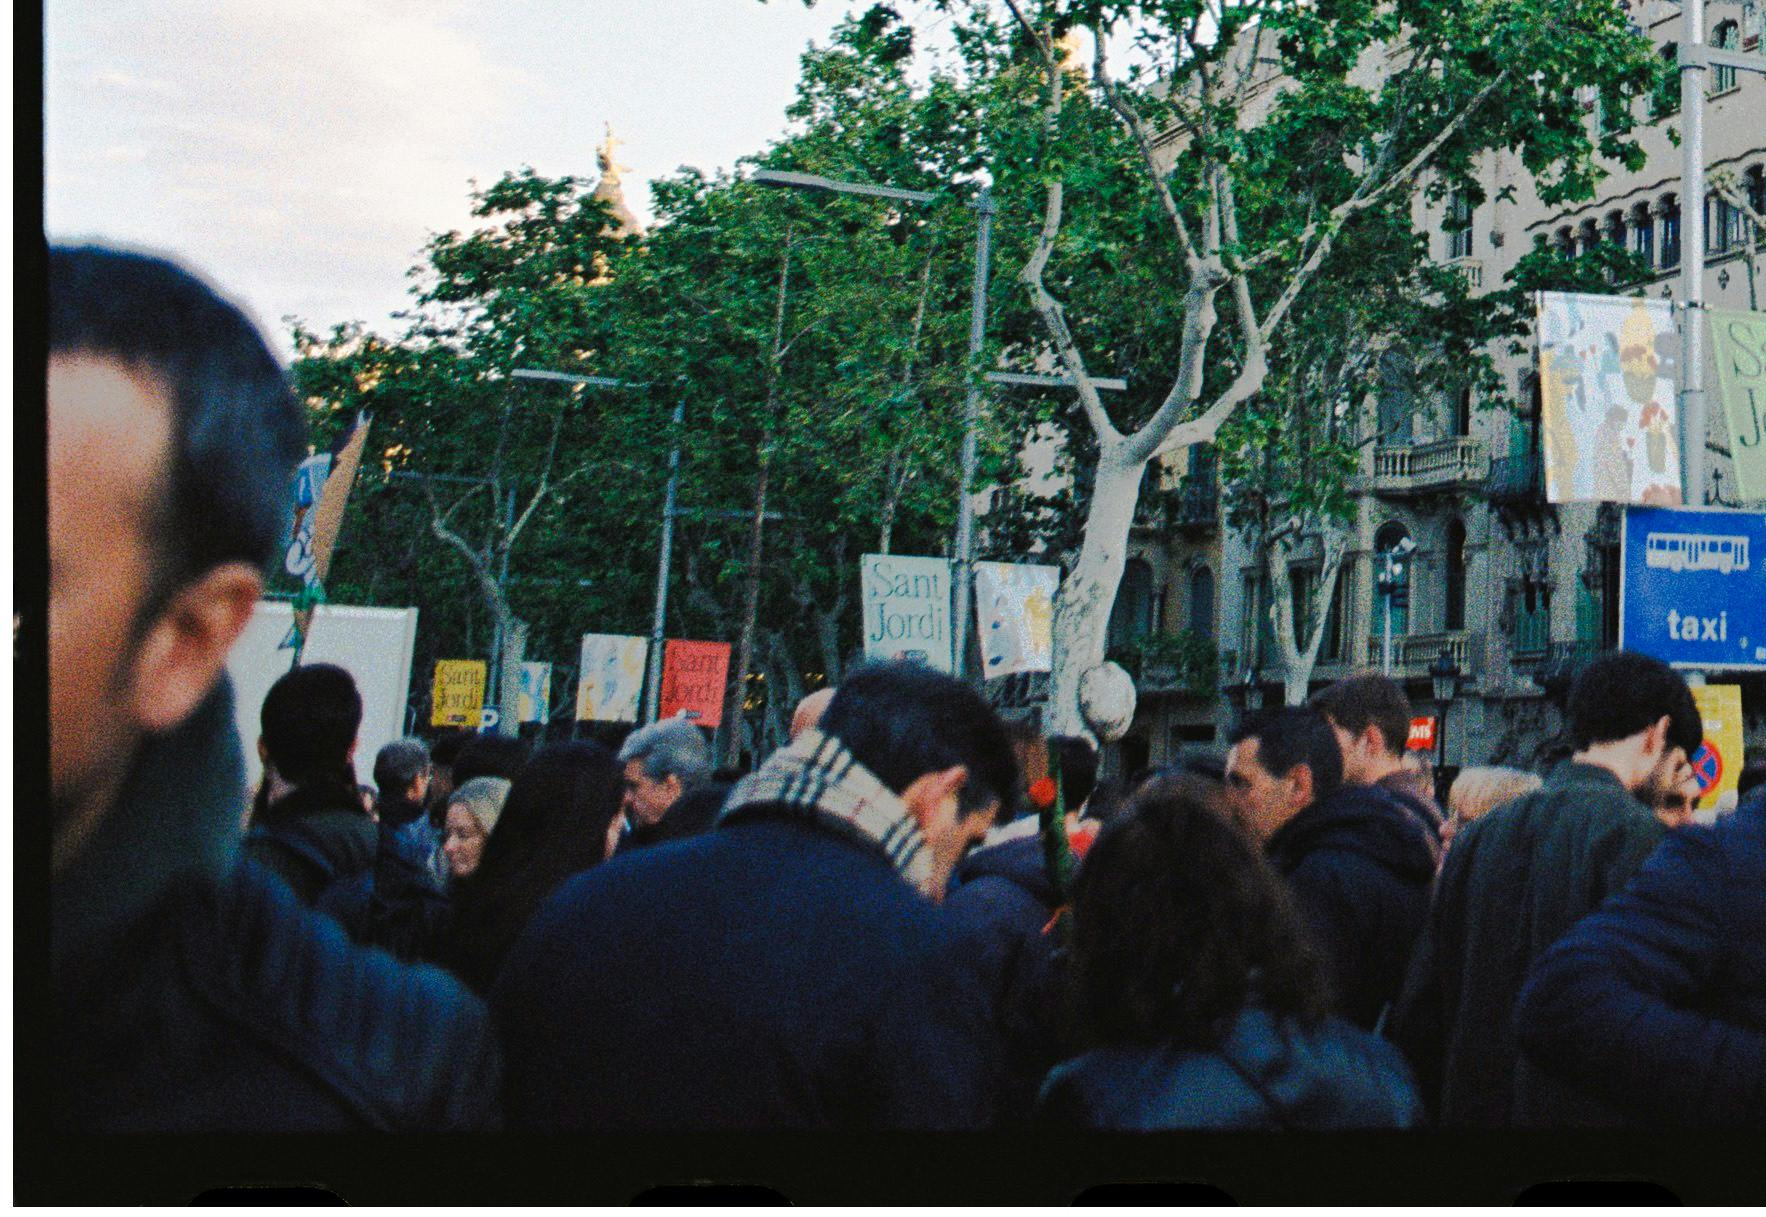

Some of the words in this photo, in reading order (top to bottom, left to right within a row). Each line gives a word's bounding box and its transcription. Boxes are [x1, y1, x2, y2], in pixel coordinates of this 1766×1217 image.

[870, 562, 942, 600] Sant
[870, 602, 943, 642] Jordi
[1667, 609, 1727, 642] taxi
[671, 646, 720, 674] Sant
[437, 665, 481, 685] Sant
[664, 674, 718, 705] Jordi
[436, 686, 481, 710] Jordi
[477, 708, 499, 734] P
